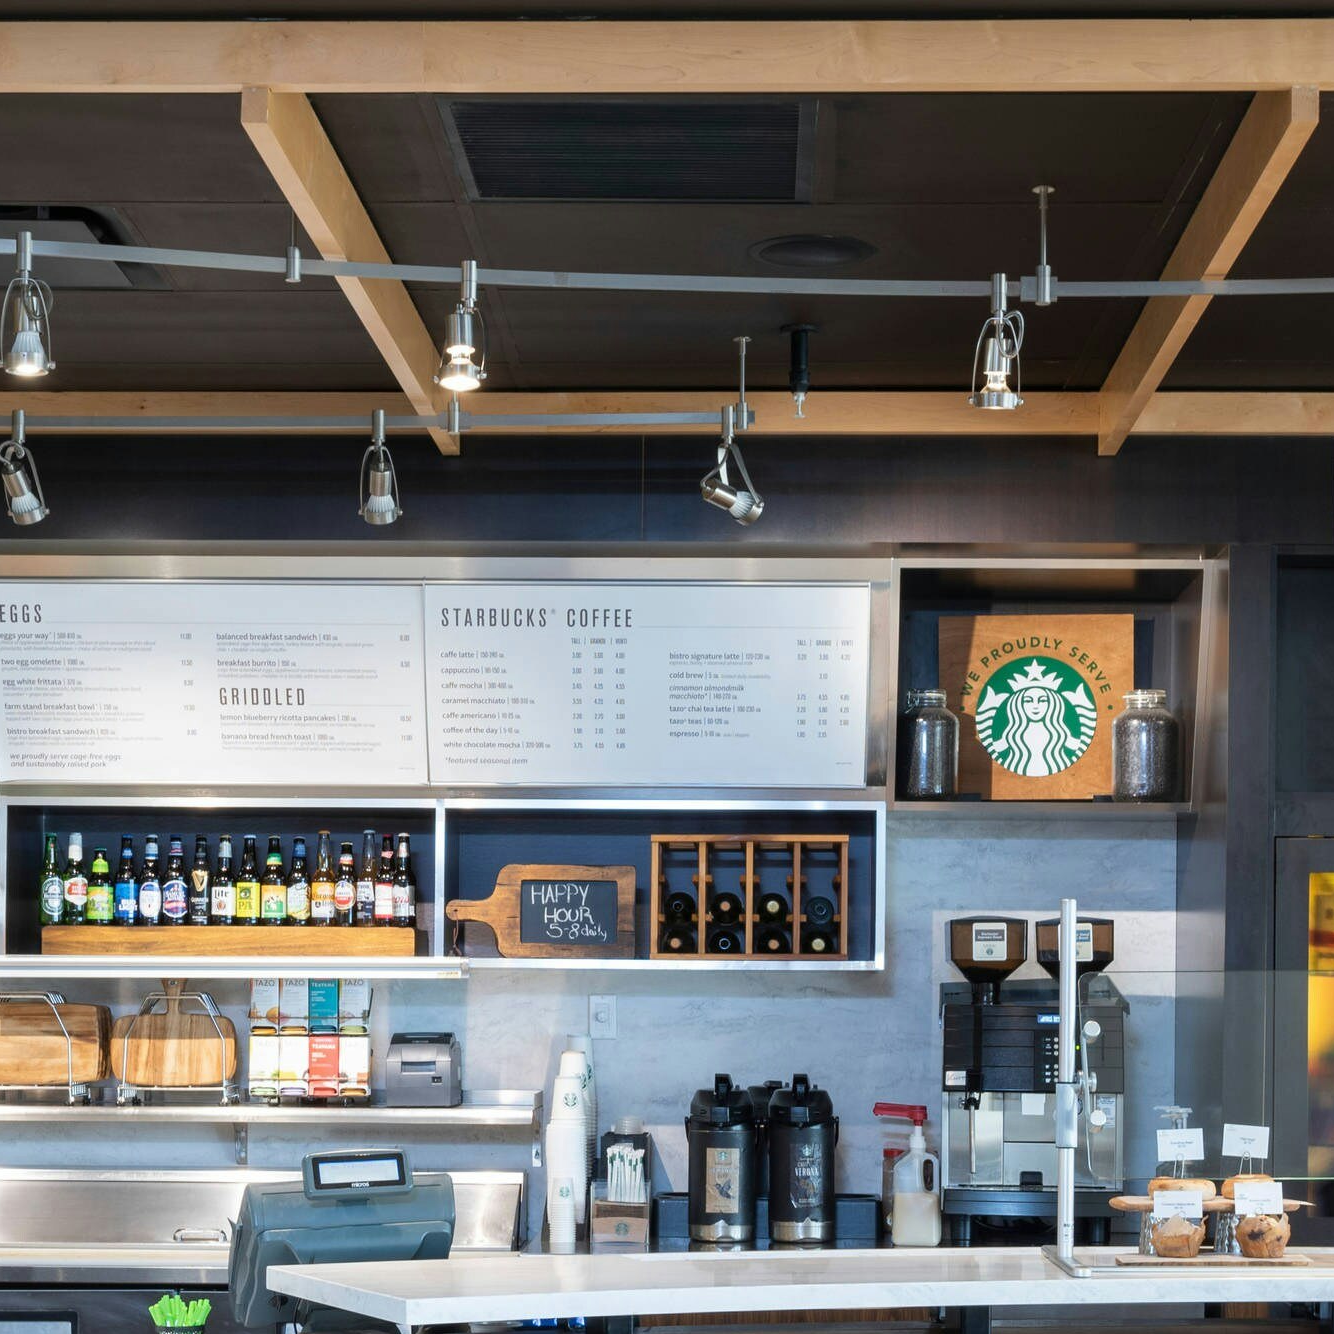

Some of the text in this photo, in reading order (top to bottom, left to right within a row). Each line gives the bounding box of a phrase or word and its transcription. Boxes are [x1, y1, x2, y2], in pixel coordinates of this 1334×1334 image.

[0, 604, 42, 623] EGGS
[567, 609, 632, 628] COFFEE
[691, 653, 722, 661] signature
[441, 667, 480, 675] cappuccino
[960, 636, 1112, 697] WE PROUDLY SERVE
[220, 687, 305, 706] GRIDDLED
[44, 703, 76, 711] breakfast
[244, 714, 277, 722] blueberry
[22, 753, 48, 761] proudly
[531, 884, 589, 905] HAPPY
[544, 906, 594, 924] HOUR
[546, 923, 607, 941] 5-8 daily
[255, 979, 275, 987] TAZO
